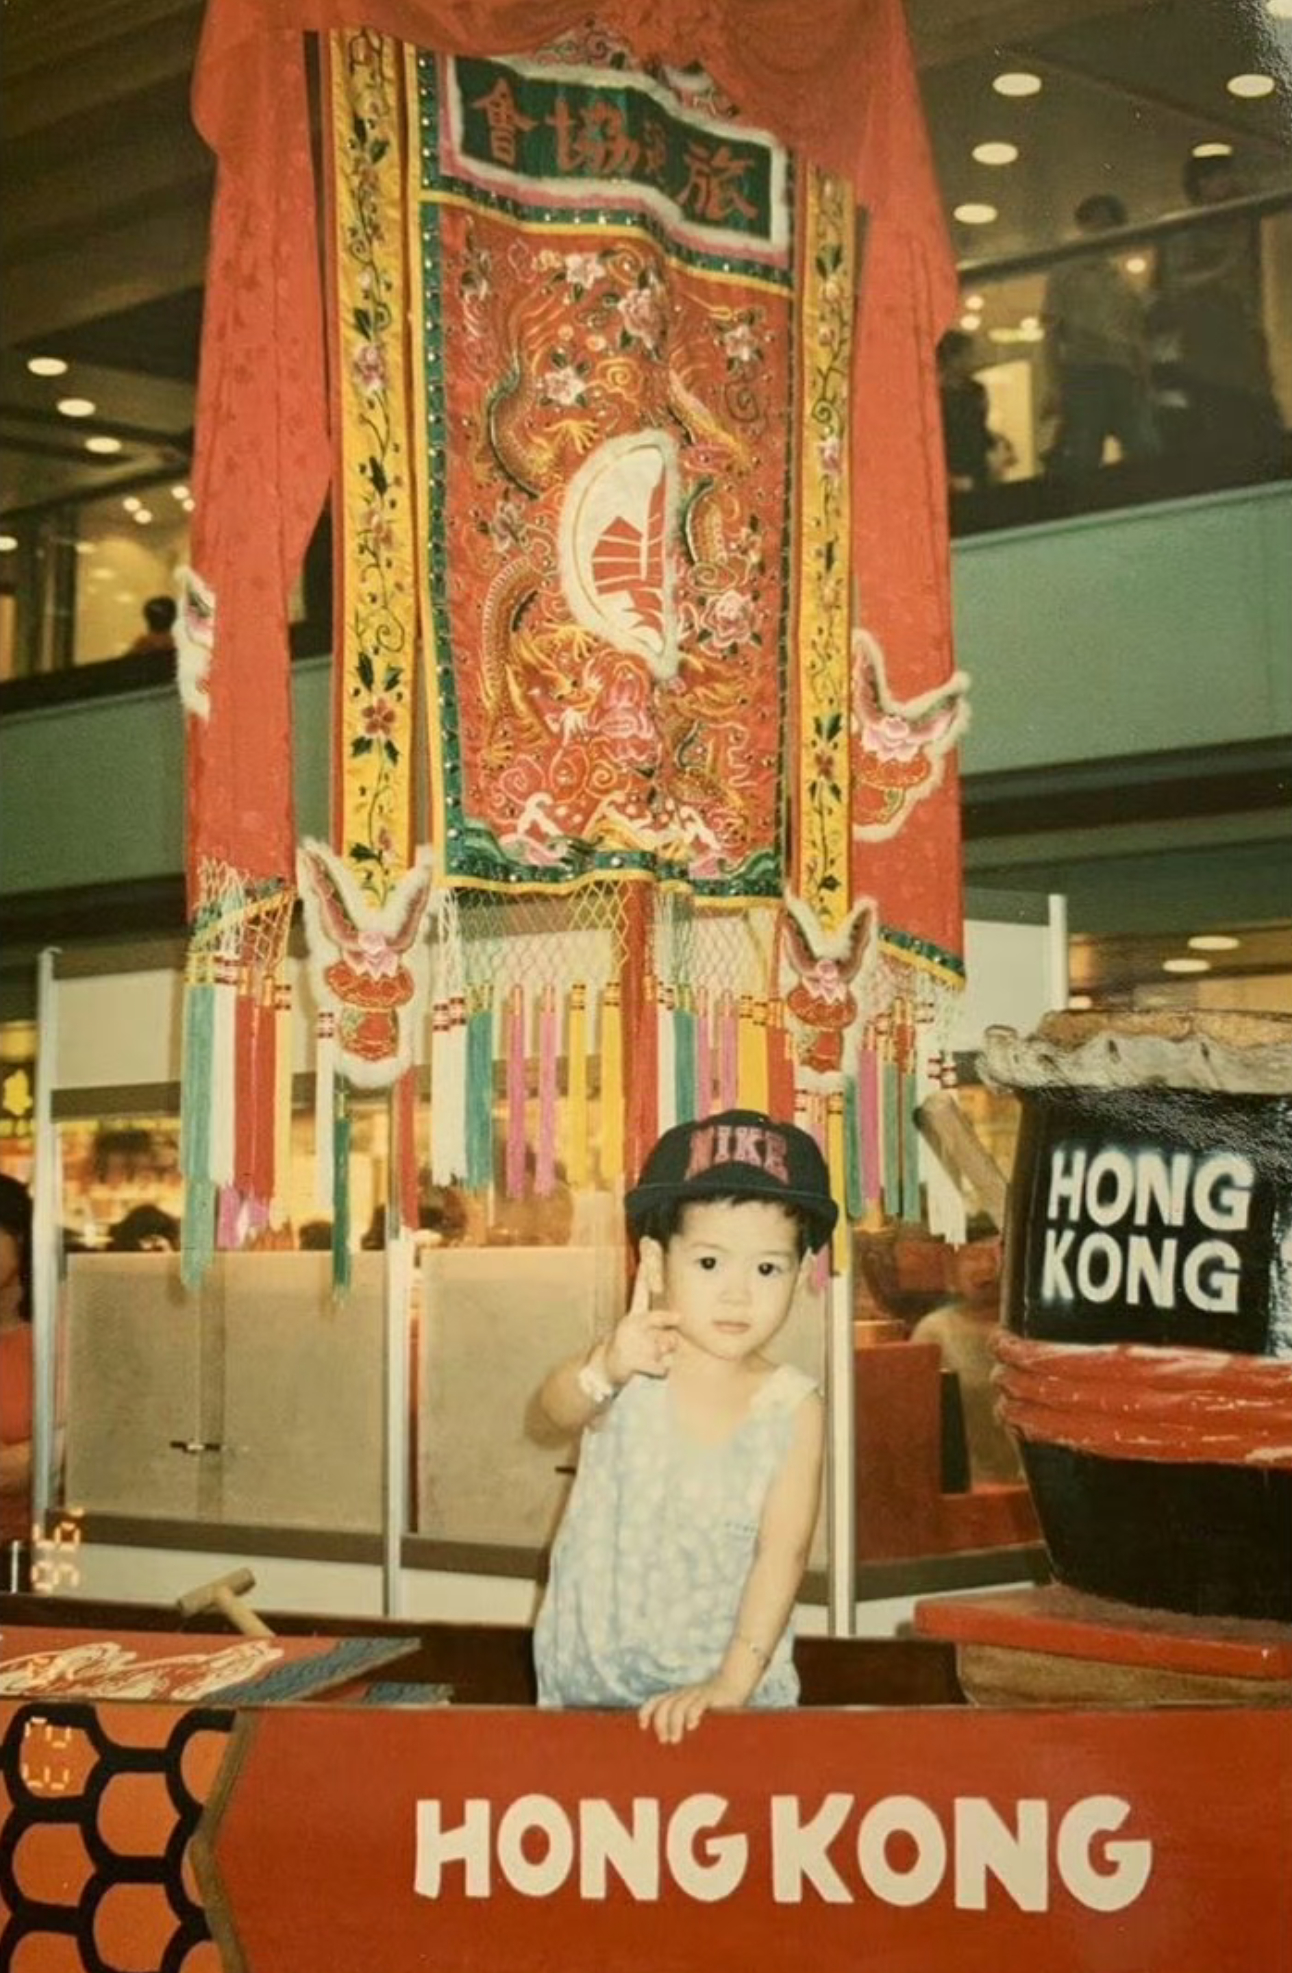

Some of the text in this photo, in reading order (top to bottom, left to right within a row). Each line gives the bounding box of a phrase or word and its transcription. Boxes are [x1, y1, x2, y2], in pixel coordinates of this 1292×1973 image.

[683, 1124, 790, 1184] NIKE
[1047, 1149, 1255, 1231] HONG
[1042, 1228, 1242, 1313] KONG
[414, 1793, 1153, 1913] HONG KONG
